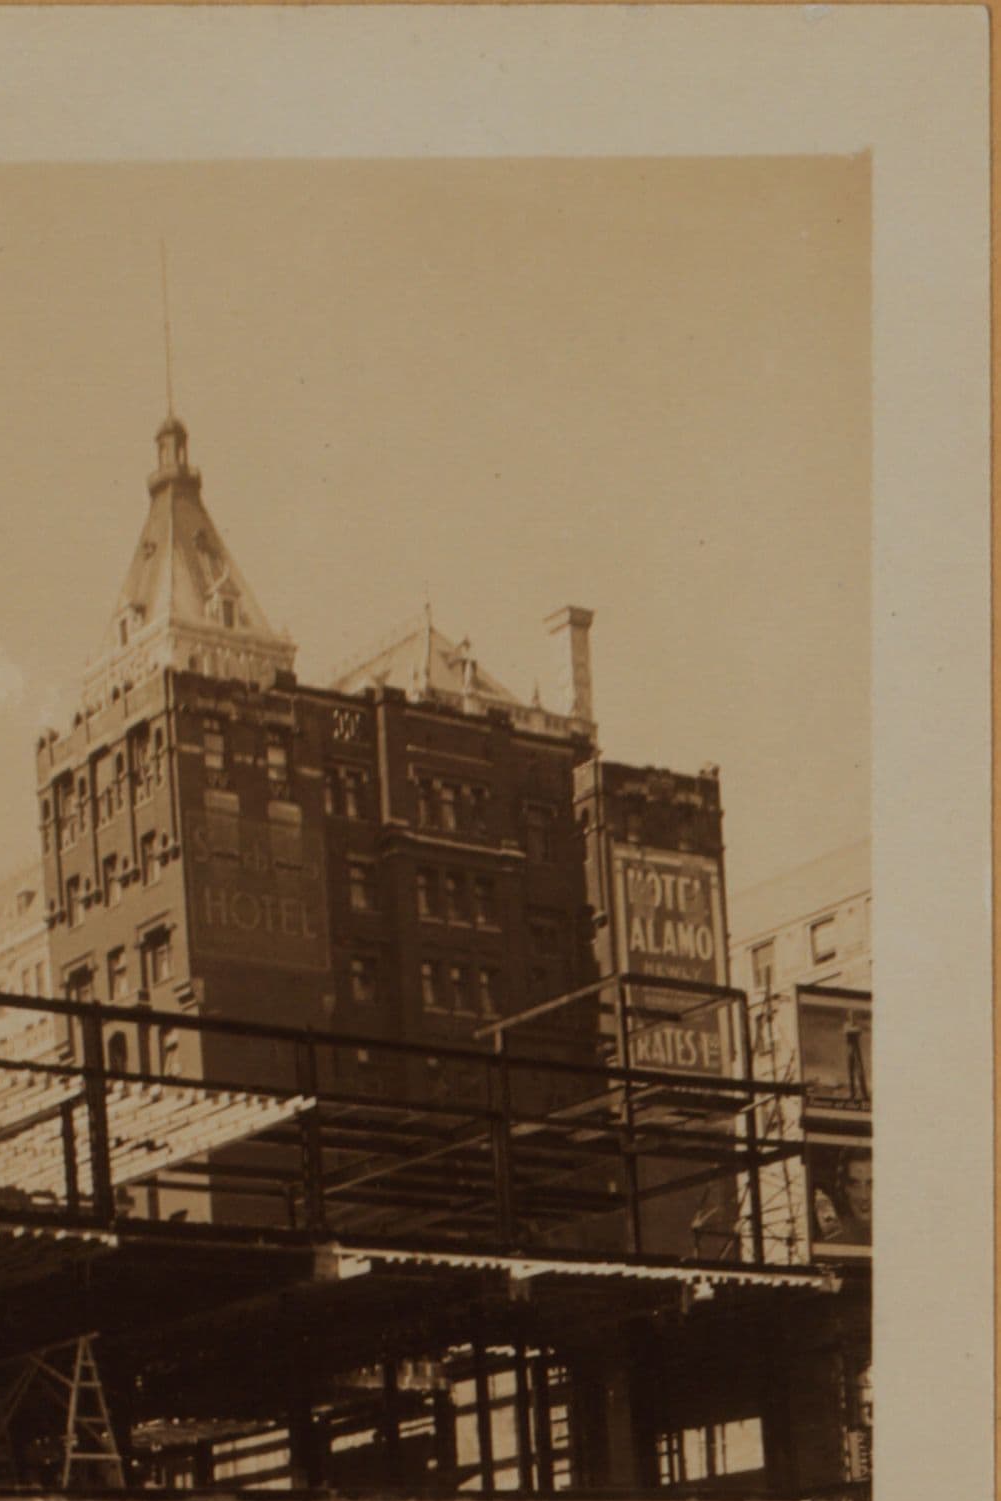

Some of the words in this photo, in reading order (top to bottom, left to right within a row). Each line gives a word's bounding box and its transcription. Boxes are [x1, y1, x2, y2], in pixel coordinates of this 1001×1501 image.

[204, 887, 317, 939] HOTEL
[630, 917, 713, 961] ALAMO
[636, 1027, 697, 1067] RATES
